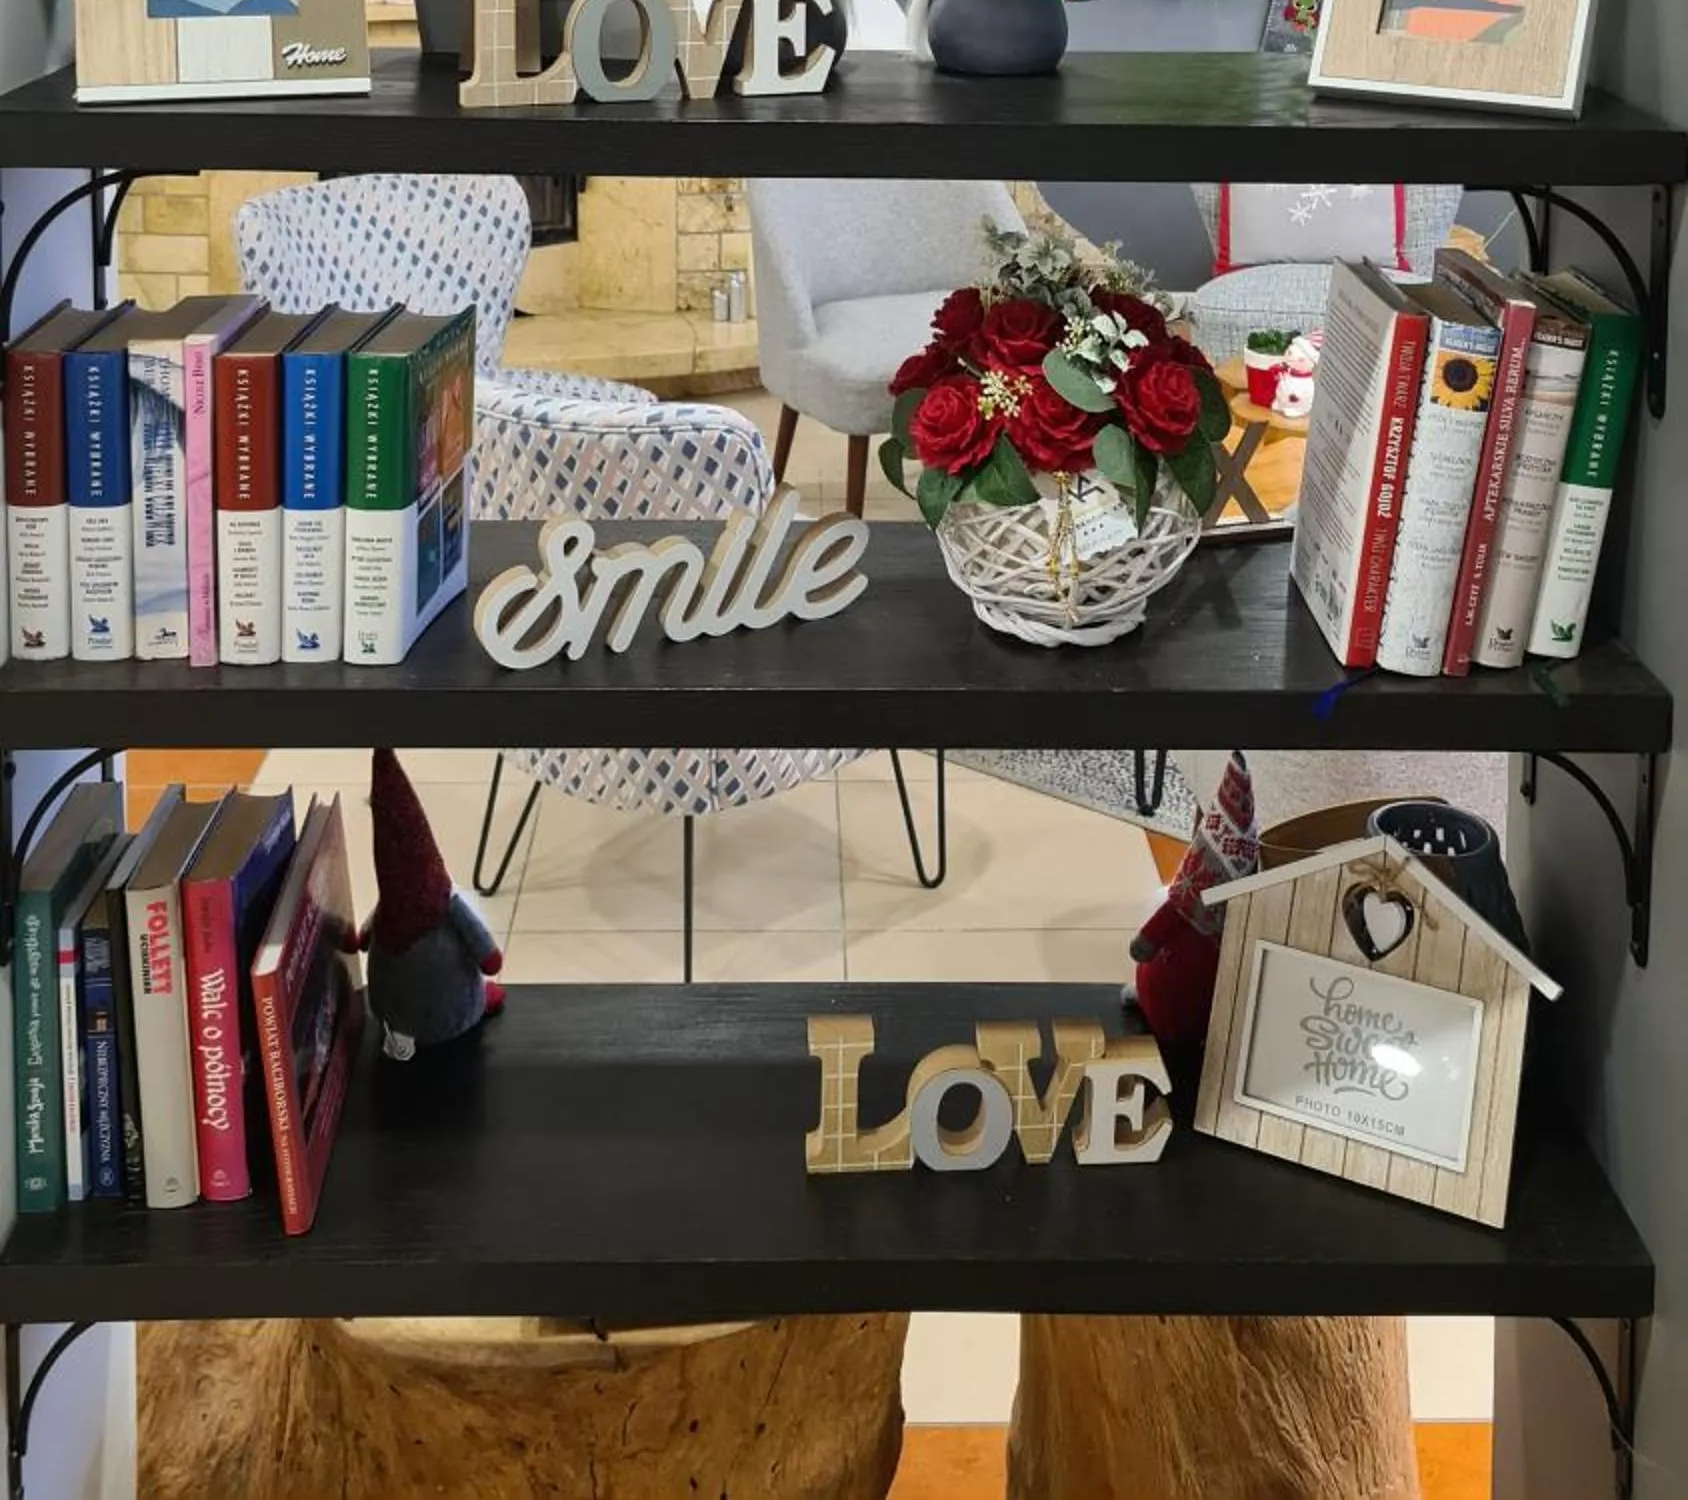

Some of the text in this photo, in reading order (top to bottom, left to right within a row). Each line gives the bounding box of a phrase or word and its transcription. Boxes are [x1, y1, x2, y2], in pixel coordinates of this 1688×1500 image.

[281, 41, 349, 70] Home
[23, 365, 37, 497] KSIĄŻKI WYBRANE
[88, 366, 104, 498] KSIĄŻKI WYBRANE
[235, 368, 250, 500] KSIĄŻKI WYBRANE
[302, 368, 317, 500] KSIĄŻKI WYBRANE
[364, 368, 379, 500] KSIĄŻKI WYBRANE
[1381, 416, 1406, 479] KRZYSZTOF
[1483, 435, 1512, 522] APTEKARSKIE
[1499, 392, 1518, 434] SILVA
[473, 482, 870, 670] Smile
[145, 899, 173, 996] FOLLETT
[200, 968, 226, 1021] Walc
[203, 1025, 218, 1042] o
[1300, 1015, 1418, 1061] Swe
[1303, 1051, 1409, 1101] Home
[199, 1044, 230, 1131] północy
[805, 1013, 1173, 1174] LOVE
[1295, 1096, 1406, 1137] PHOTO 10X15CM
